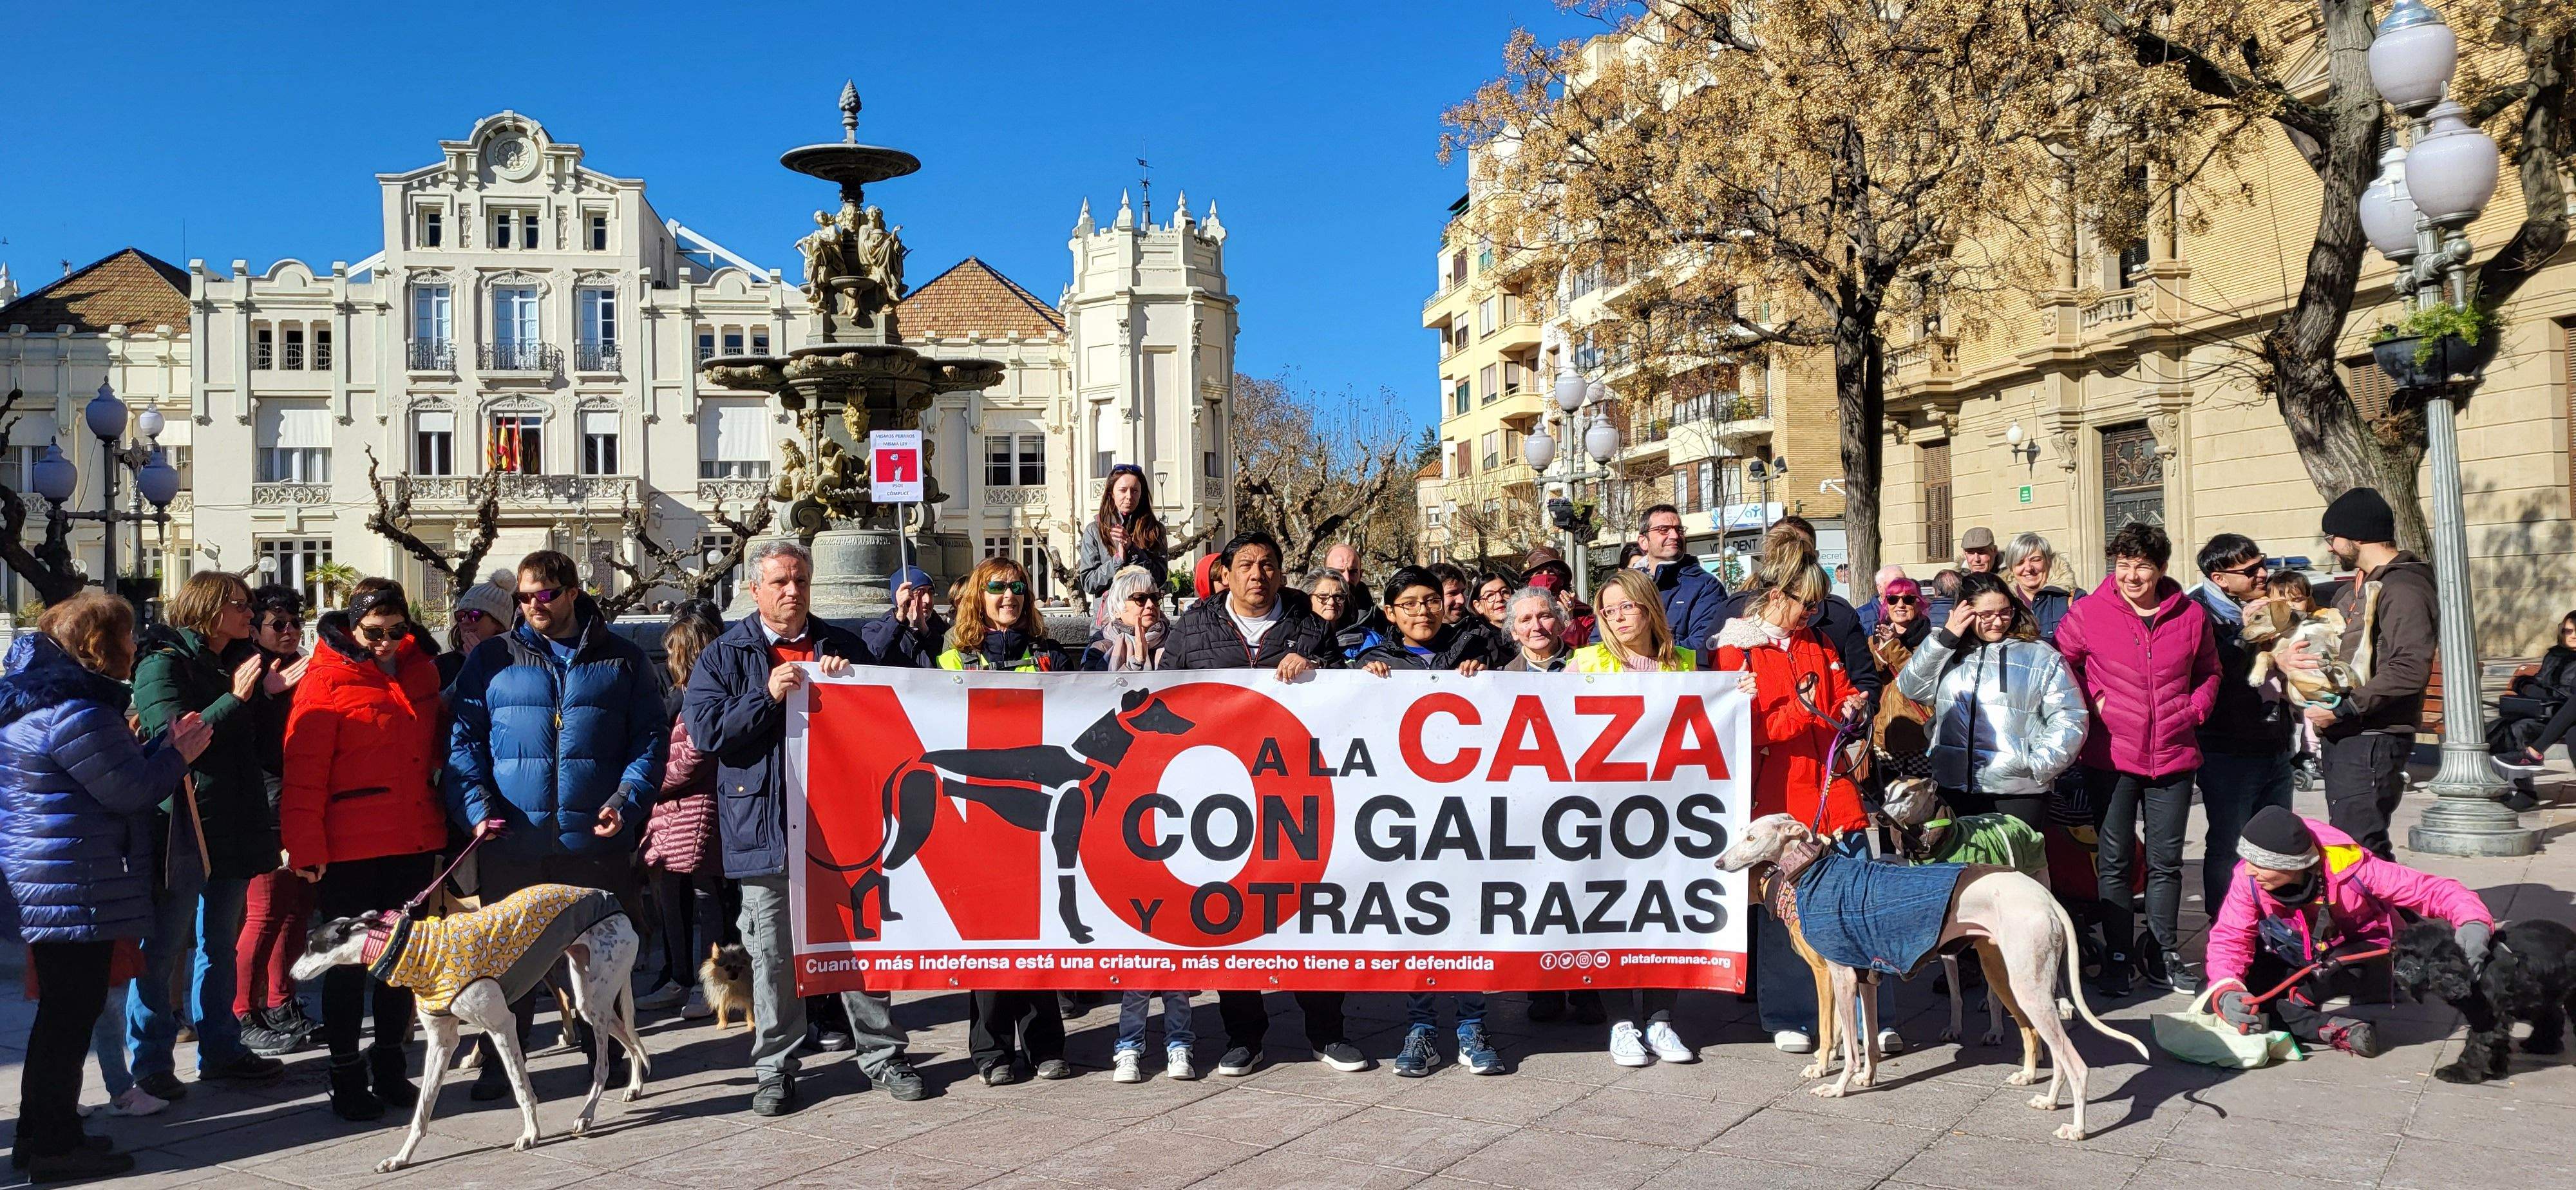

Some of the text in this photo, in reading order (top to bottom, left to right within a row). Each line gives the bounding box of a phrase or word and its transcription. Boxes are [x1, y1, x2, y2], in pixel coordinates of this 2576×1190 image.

[1253, 692, 1731, 783] A LA CAZA
[806, 683, 1335, 948] NO
[1122, 793, 1728, 862] CON GALGOS
[1130, 878, 1728, 936] Y OTRAS RAZAS
[806, 954, 1494, 974] Cuanto más indefensa está una criatura, más derecho tiene a ser defendida
[1620, 953, 1731, 968] plataformanac.org
